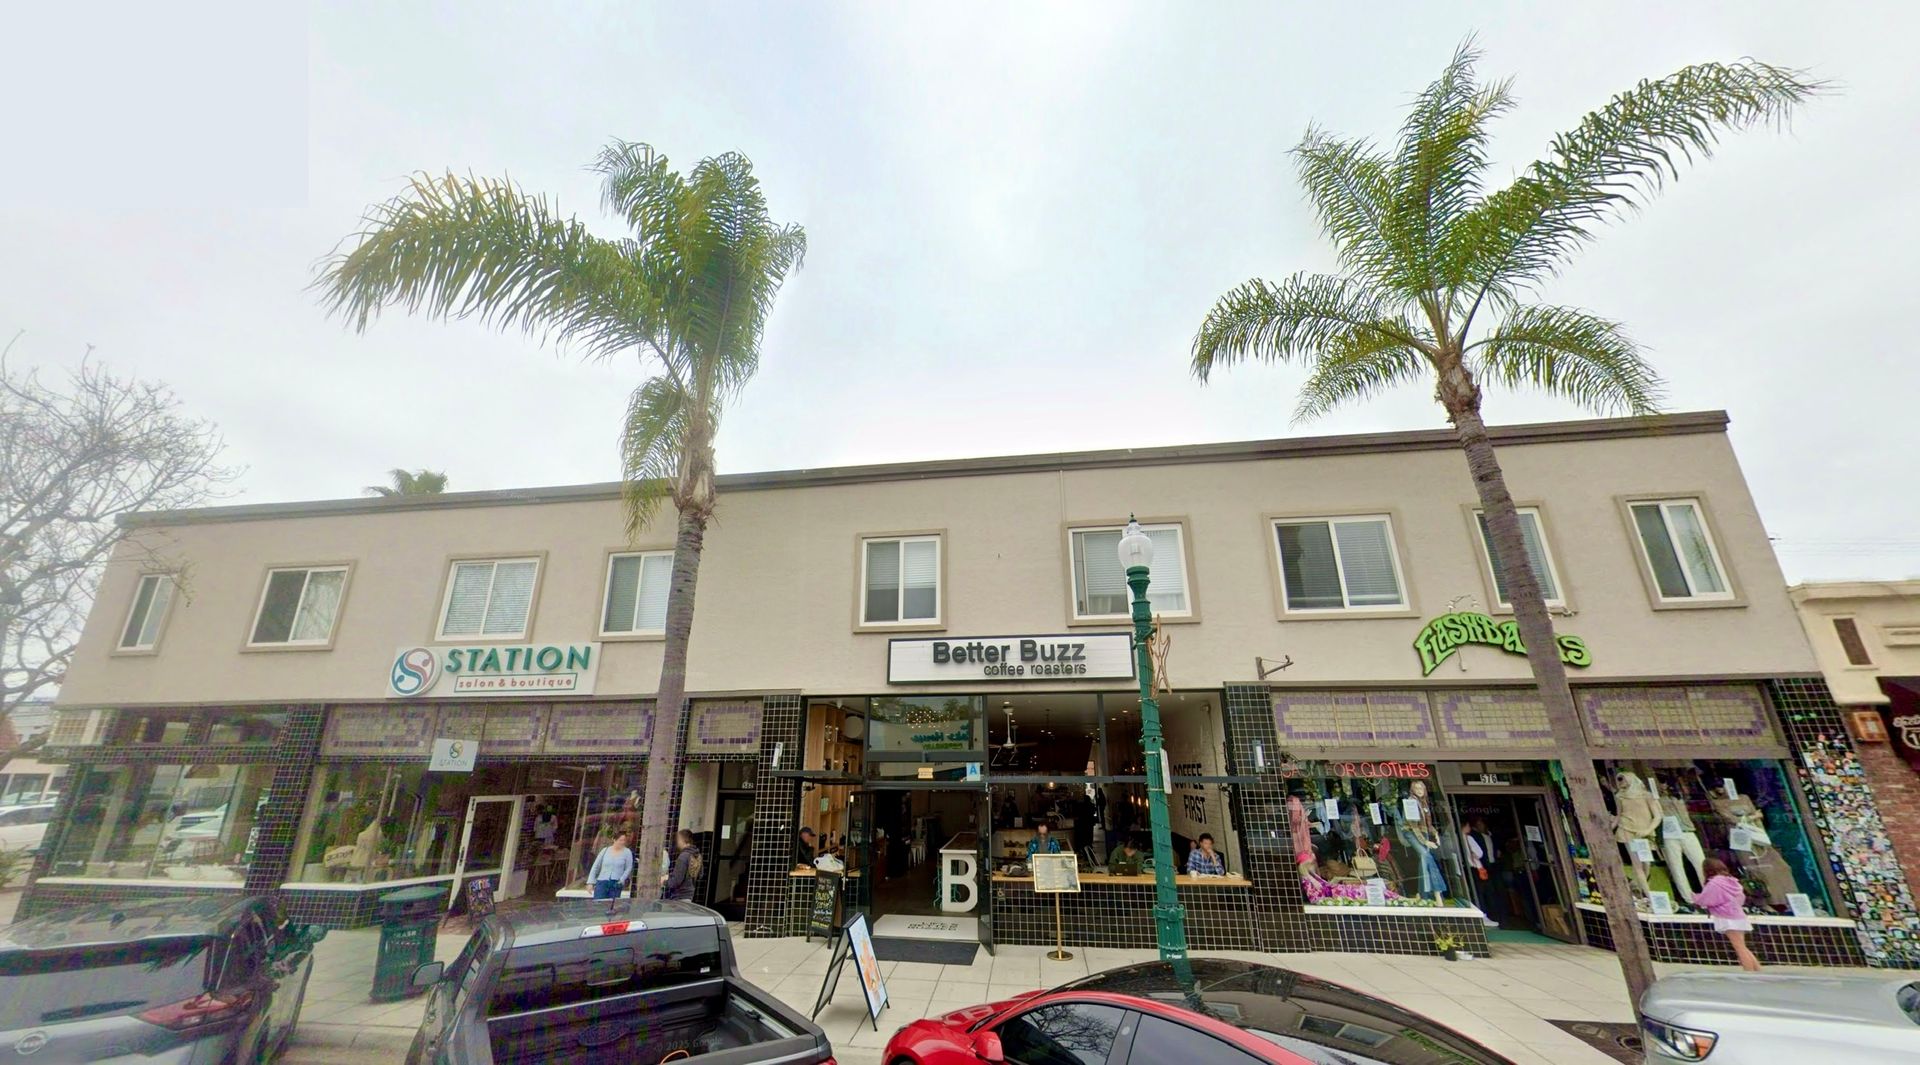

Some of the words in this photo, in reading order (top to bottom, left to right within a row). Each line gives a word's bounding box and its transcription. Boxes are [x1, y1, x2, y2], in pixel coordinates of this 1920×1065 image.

[933, 641, 1010, 664] Better
[1020, 639, 1087, 662] Buzz
[1414, 612, 1592, 676] FLASHBAS
[445, 645, 592, 673] STATION
[984, 662, 1024, 676] coffee
[1030, 662, 1087, 675] roasters
[459, 678, 494, 688] salon
[498, 678, 506, 687] &
[510, 676, 573, 688] boutique
[969, 764, 977, 775] A
[1324, 762, 1356, 778] FOR
[1360, 762, 1430, 778] CLOTHES
[1481, 774, 1497, 784] 576
[1183, 794, 1208, 825] FIRST
[942, 853, 978, 913] B
